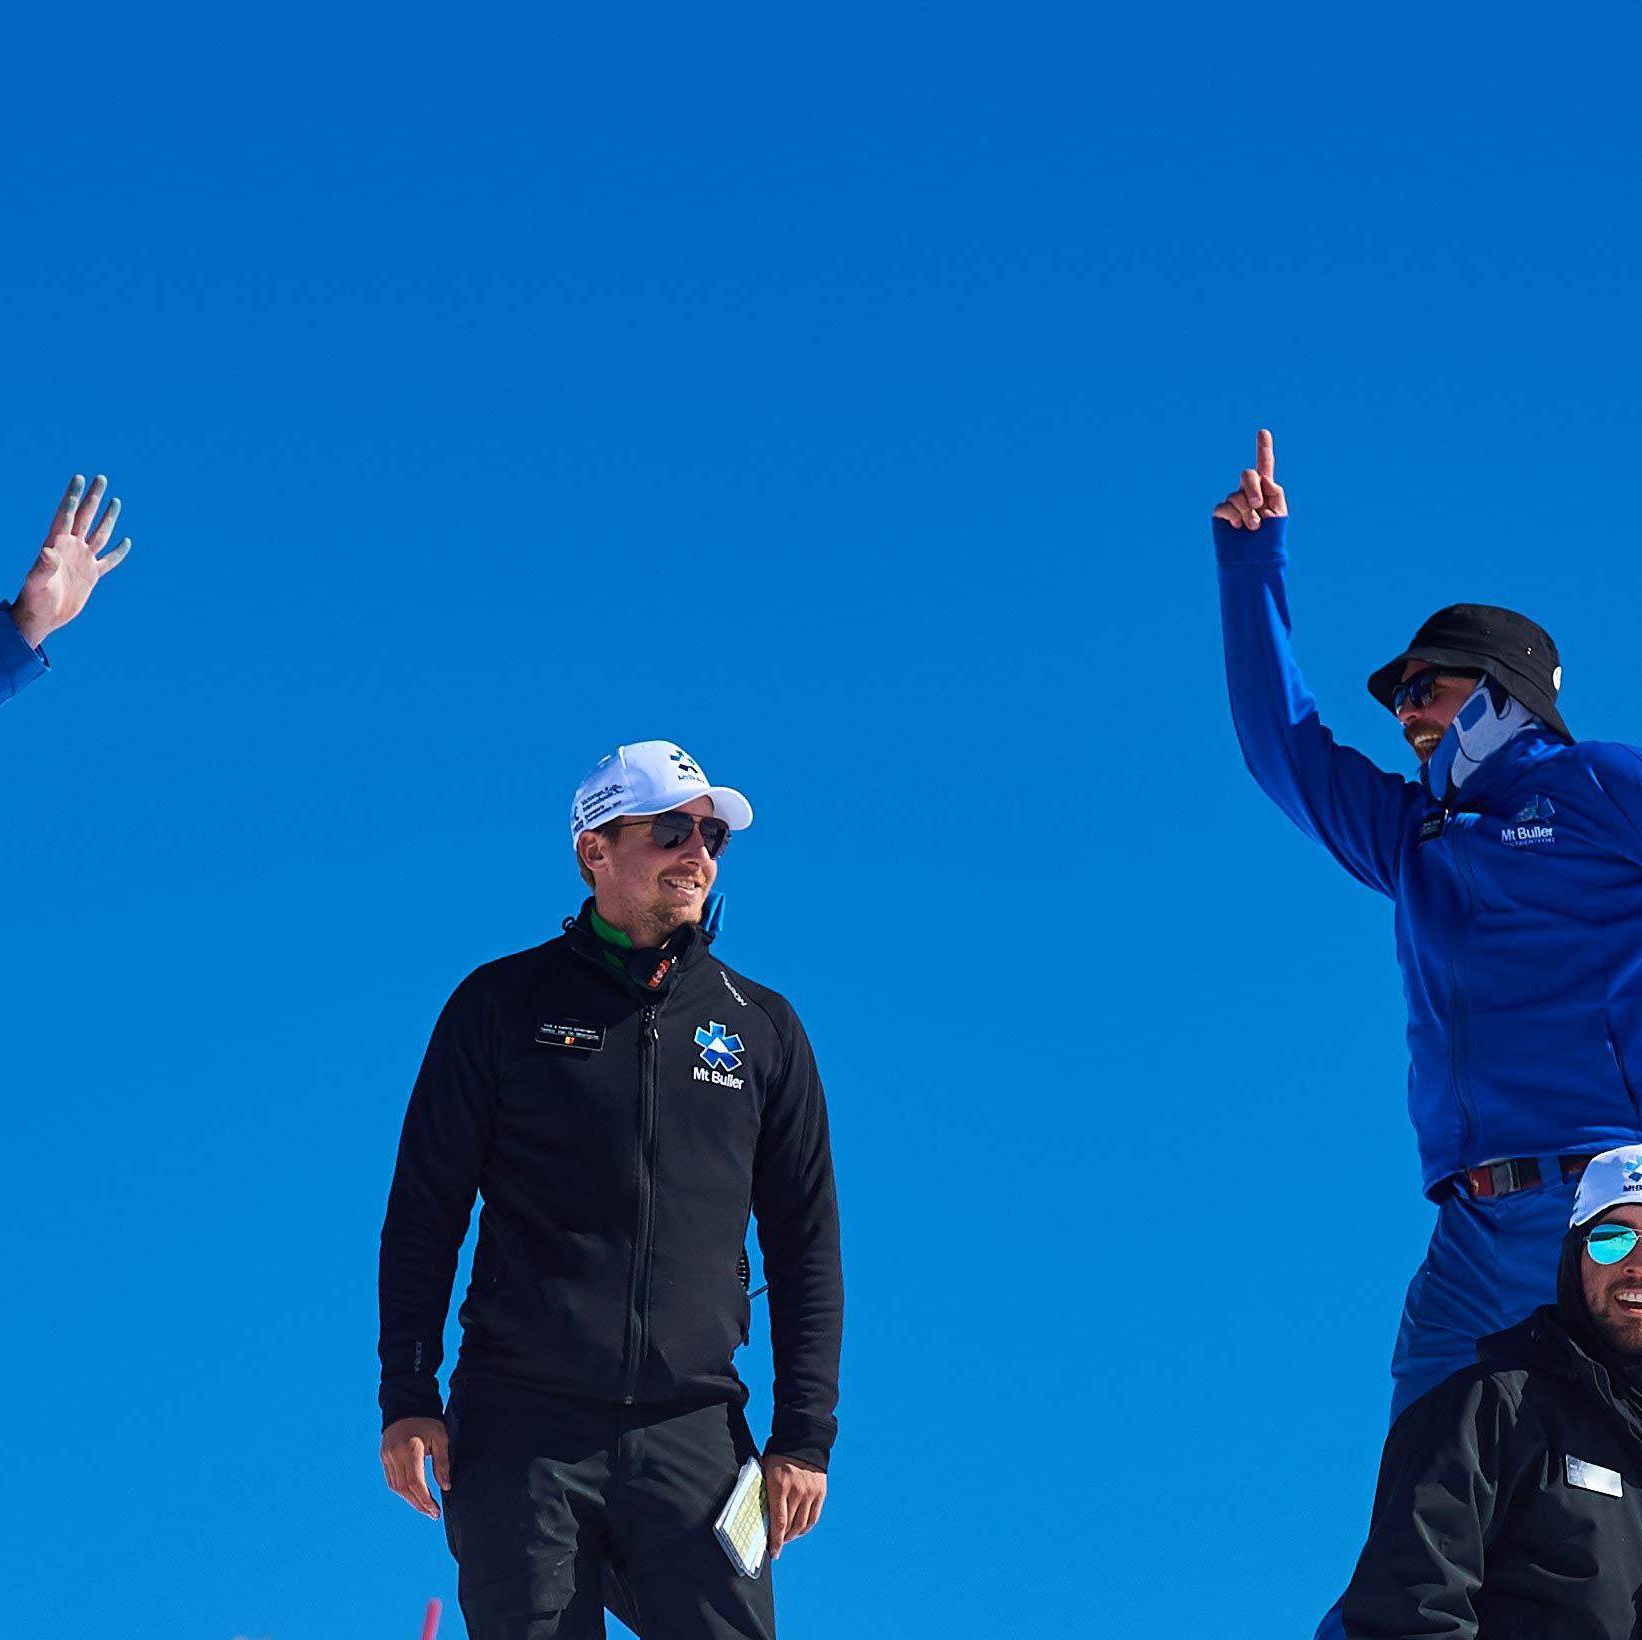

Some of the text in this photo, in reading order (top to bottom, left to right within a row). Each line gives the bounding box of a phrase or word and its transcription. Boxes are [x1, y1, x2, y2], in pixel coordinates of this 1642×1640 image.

[1517, 826, 1553, 840] Buller
[693, 1066, 745, 1090] Mt Buller
